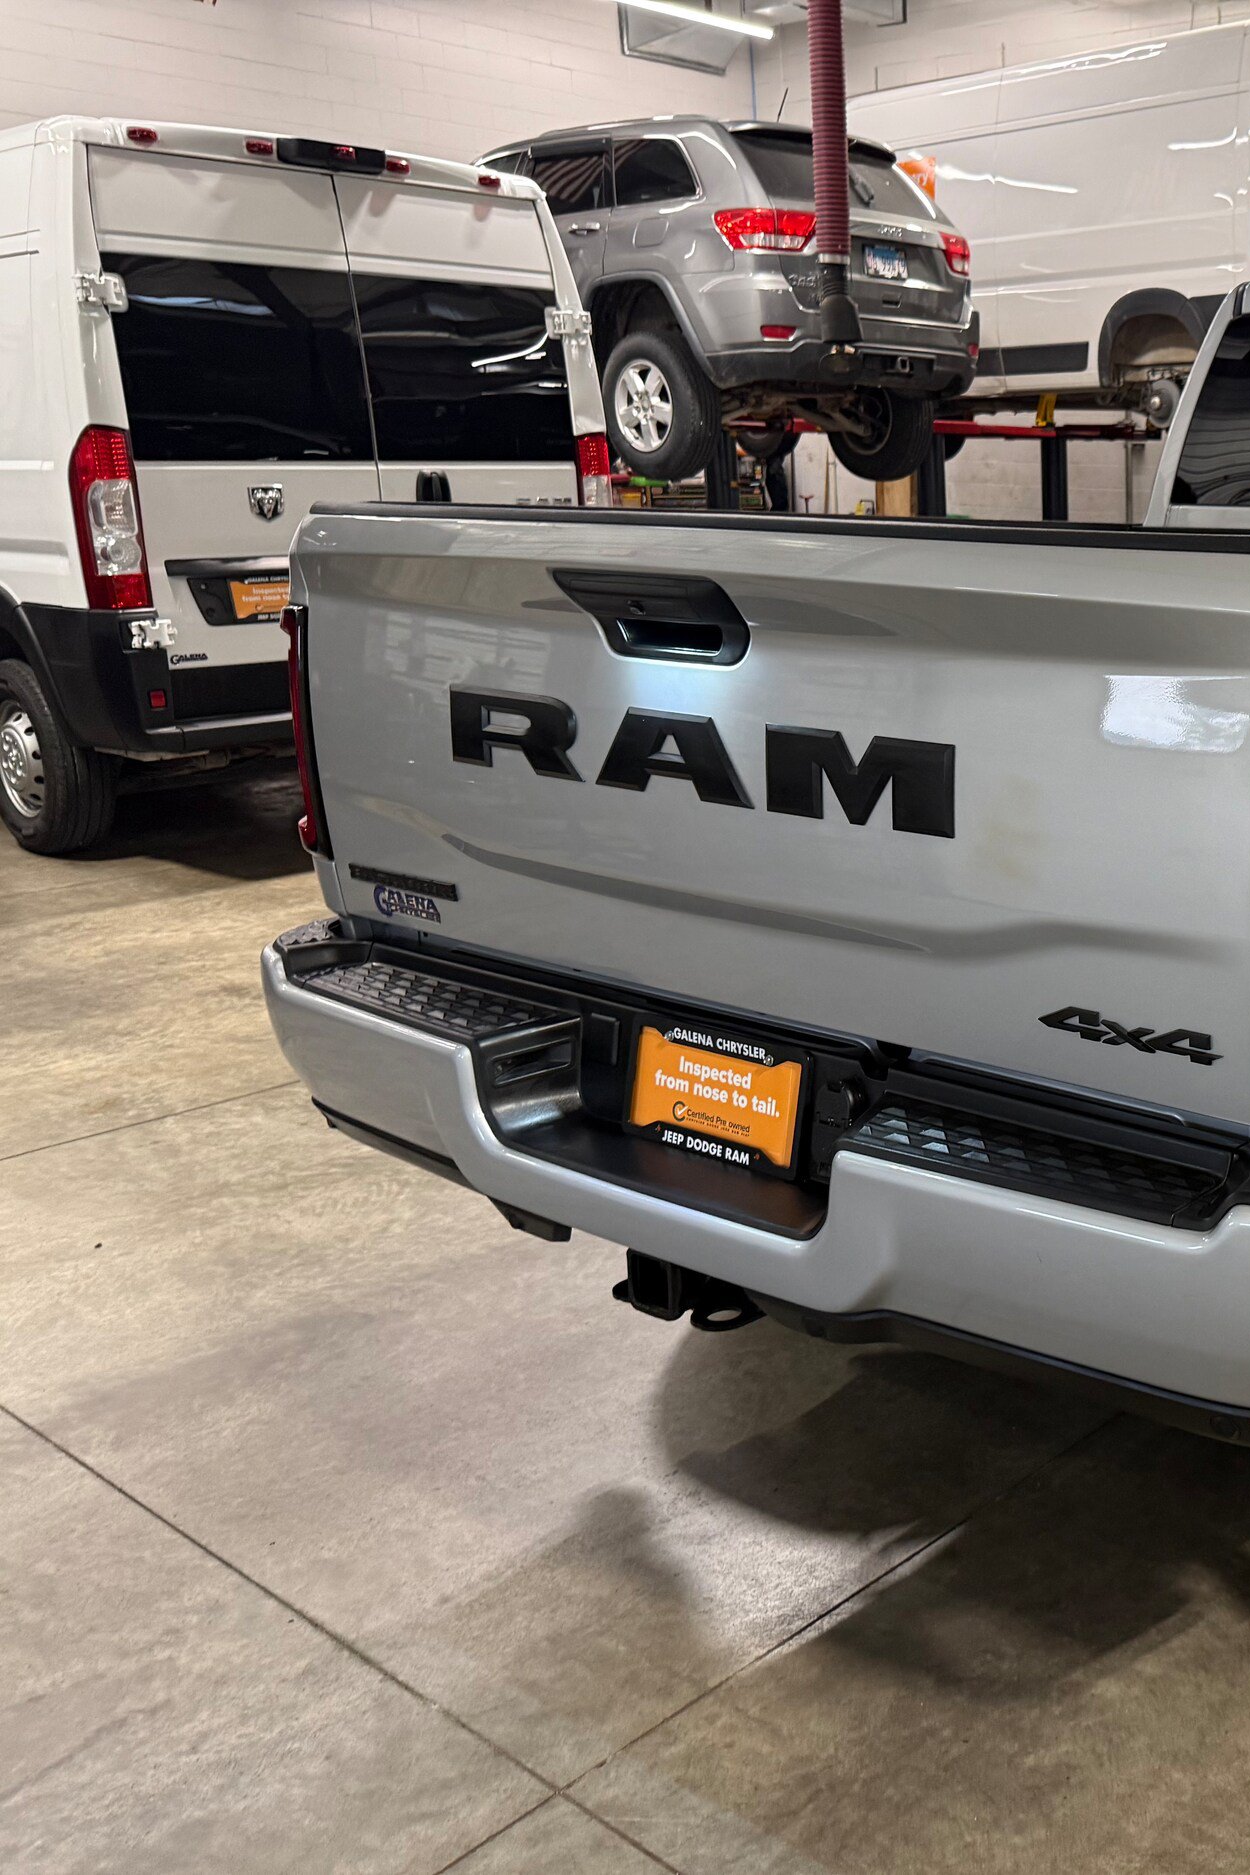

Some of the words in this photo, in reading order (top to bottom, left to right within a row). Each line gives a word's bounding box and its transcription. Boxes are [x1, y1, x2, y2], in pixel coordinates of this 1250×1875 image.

[449, 683, 956, 839] RAM
[673, 1027, 713, 1048] GALENA
[716, 1038, 766, 1060] CHRYSLER
[679, 1056, 752, 1089] Inspected
[655, 1069, 689, 1093] from
[693, 1083, 729, 1104] nose
[732, 1090, 748, 1108] to
[752, 1095, 780, 1118] tail.
[686, 1109, 714, 1123] Certified
[716, 1116, 727, 1126] Pre
[728, 1121, 751, 1133] owned
[662, 1129, 684, 1146] JEEP
[686, 1136, 723, 1157] DODGE
[725, 1148, 750, 1166] RAM
